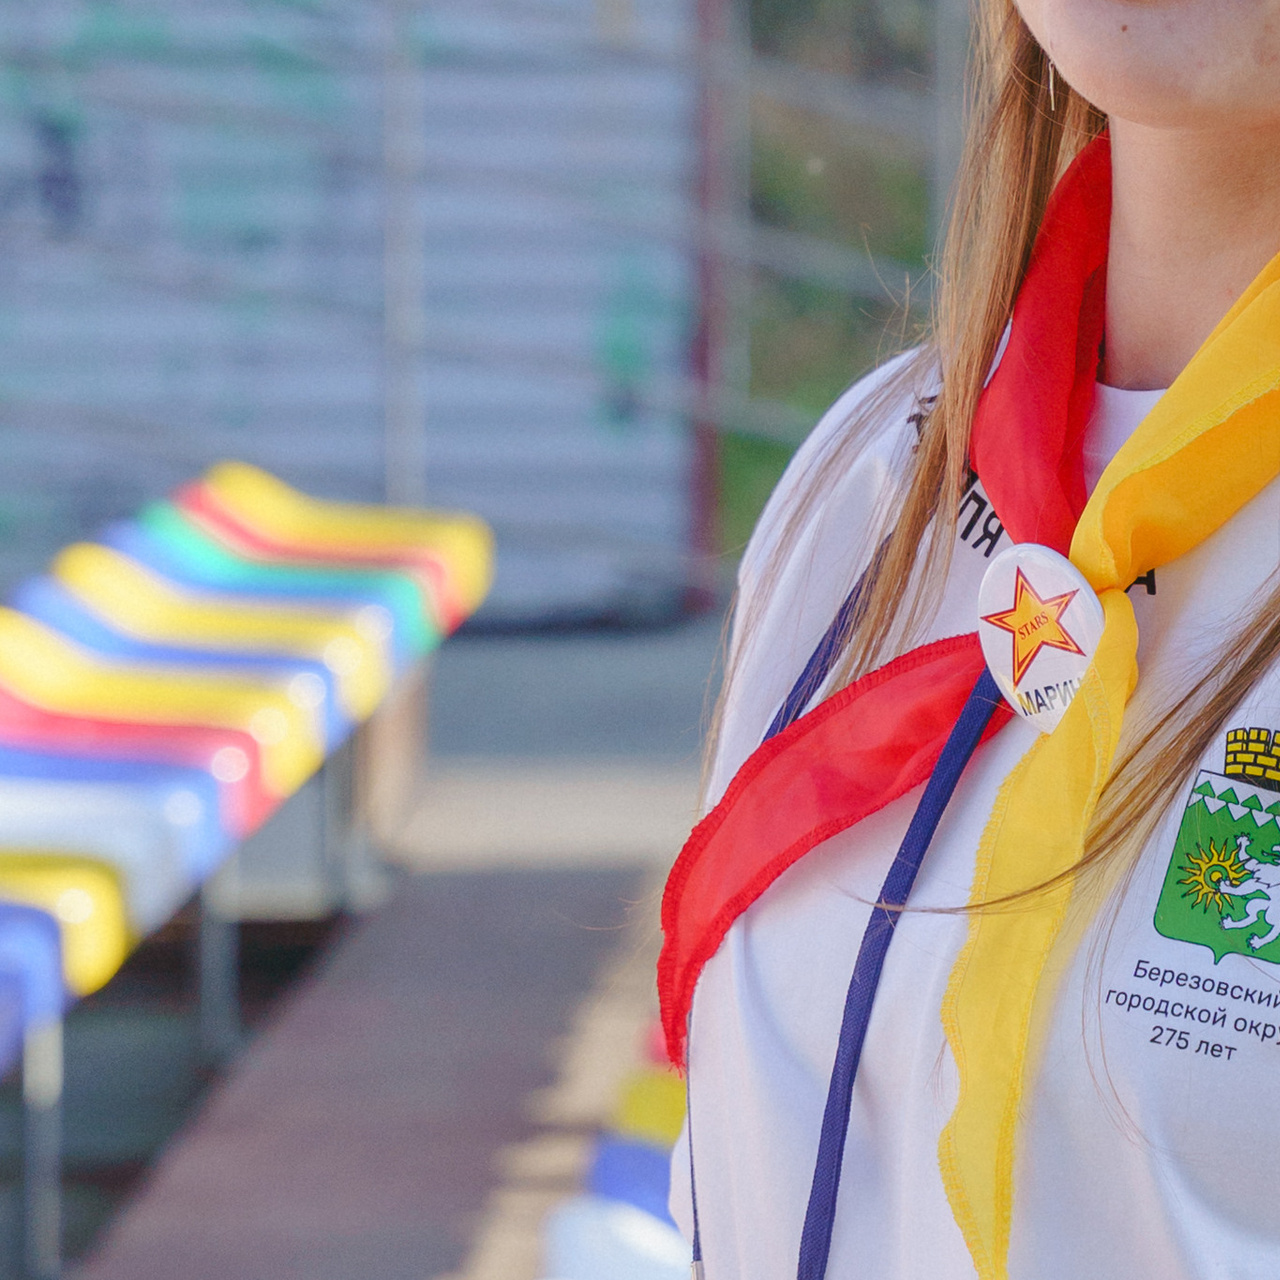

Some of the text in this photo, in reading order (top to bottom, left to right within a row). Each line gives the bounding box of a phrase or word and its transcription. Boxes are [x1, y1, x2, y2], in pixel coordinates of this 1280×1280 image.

[1017, 611, 1049, 640] STARS
[1017, 677, 1082, 717] МАРИН
[1105, 989, 1227, 1028] городской
[1149, 1025, 1237, 1060] 275 лет
